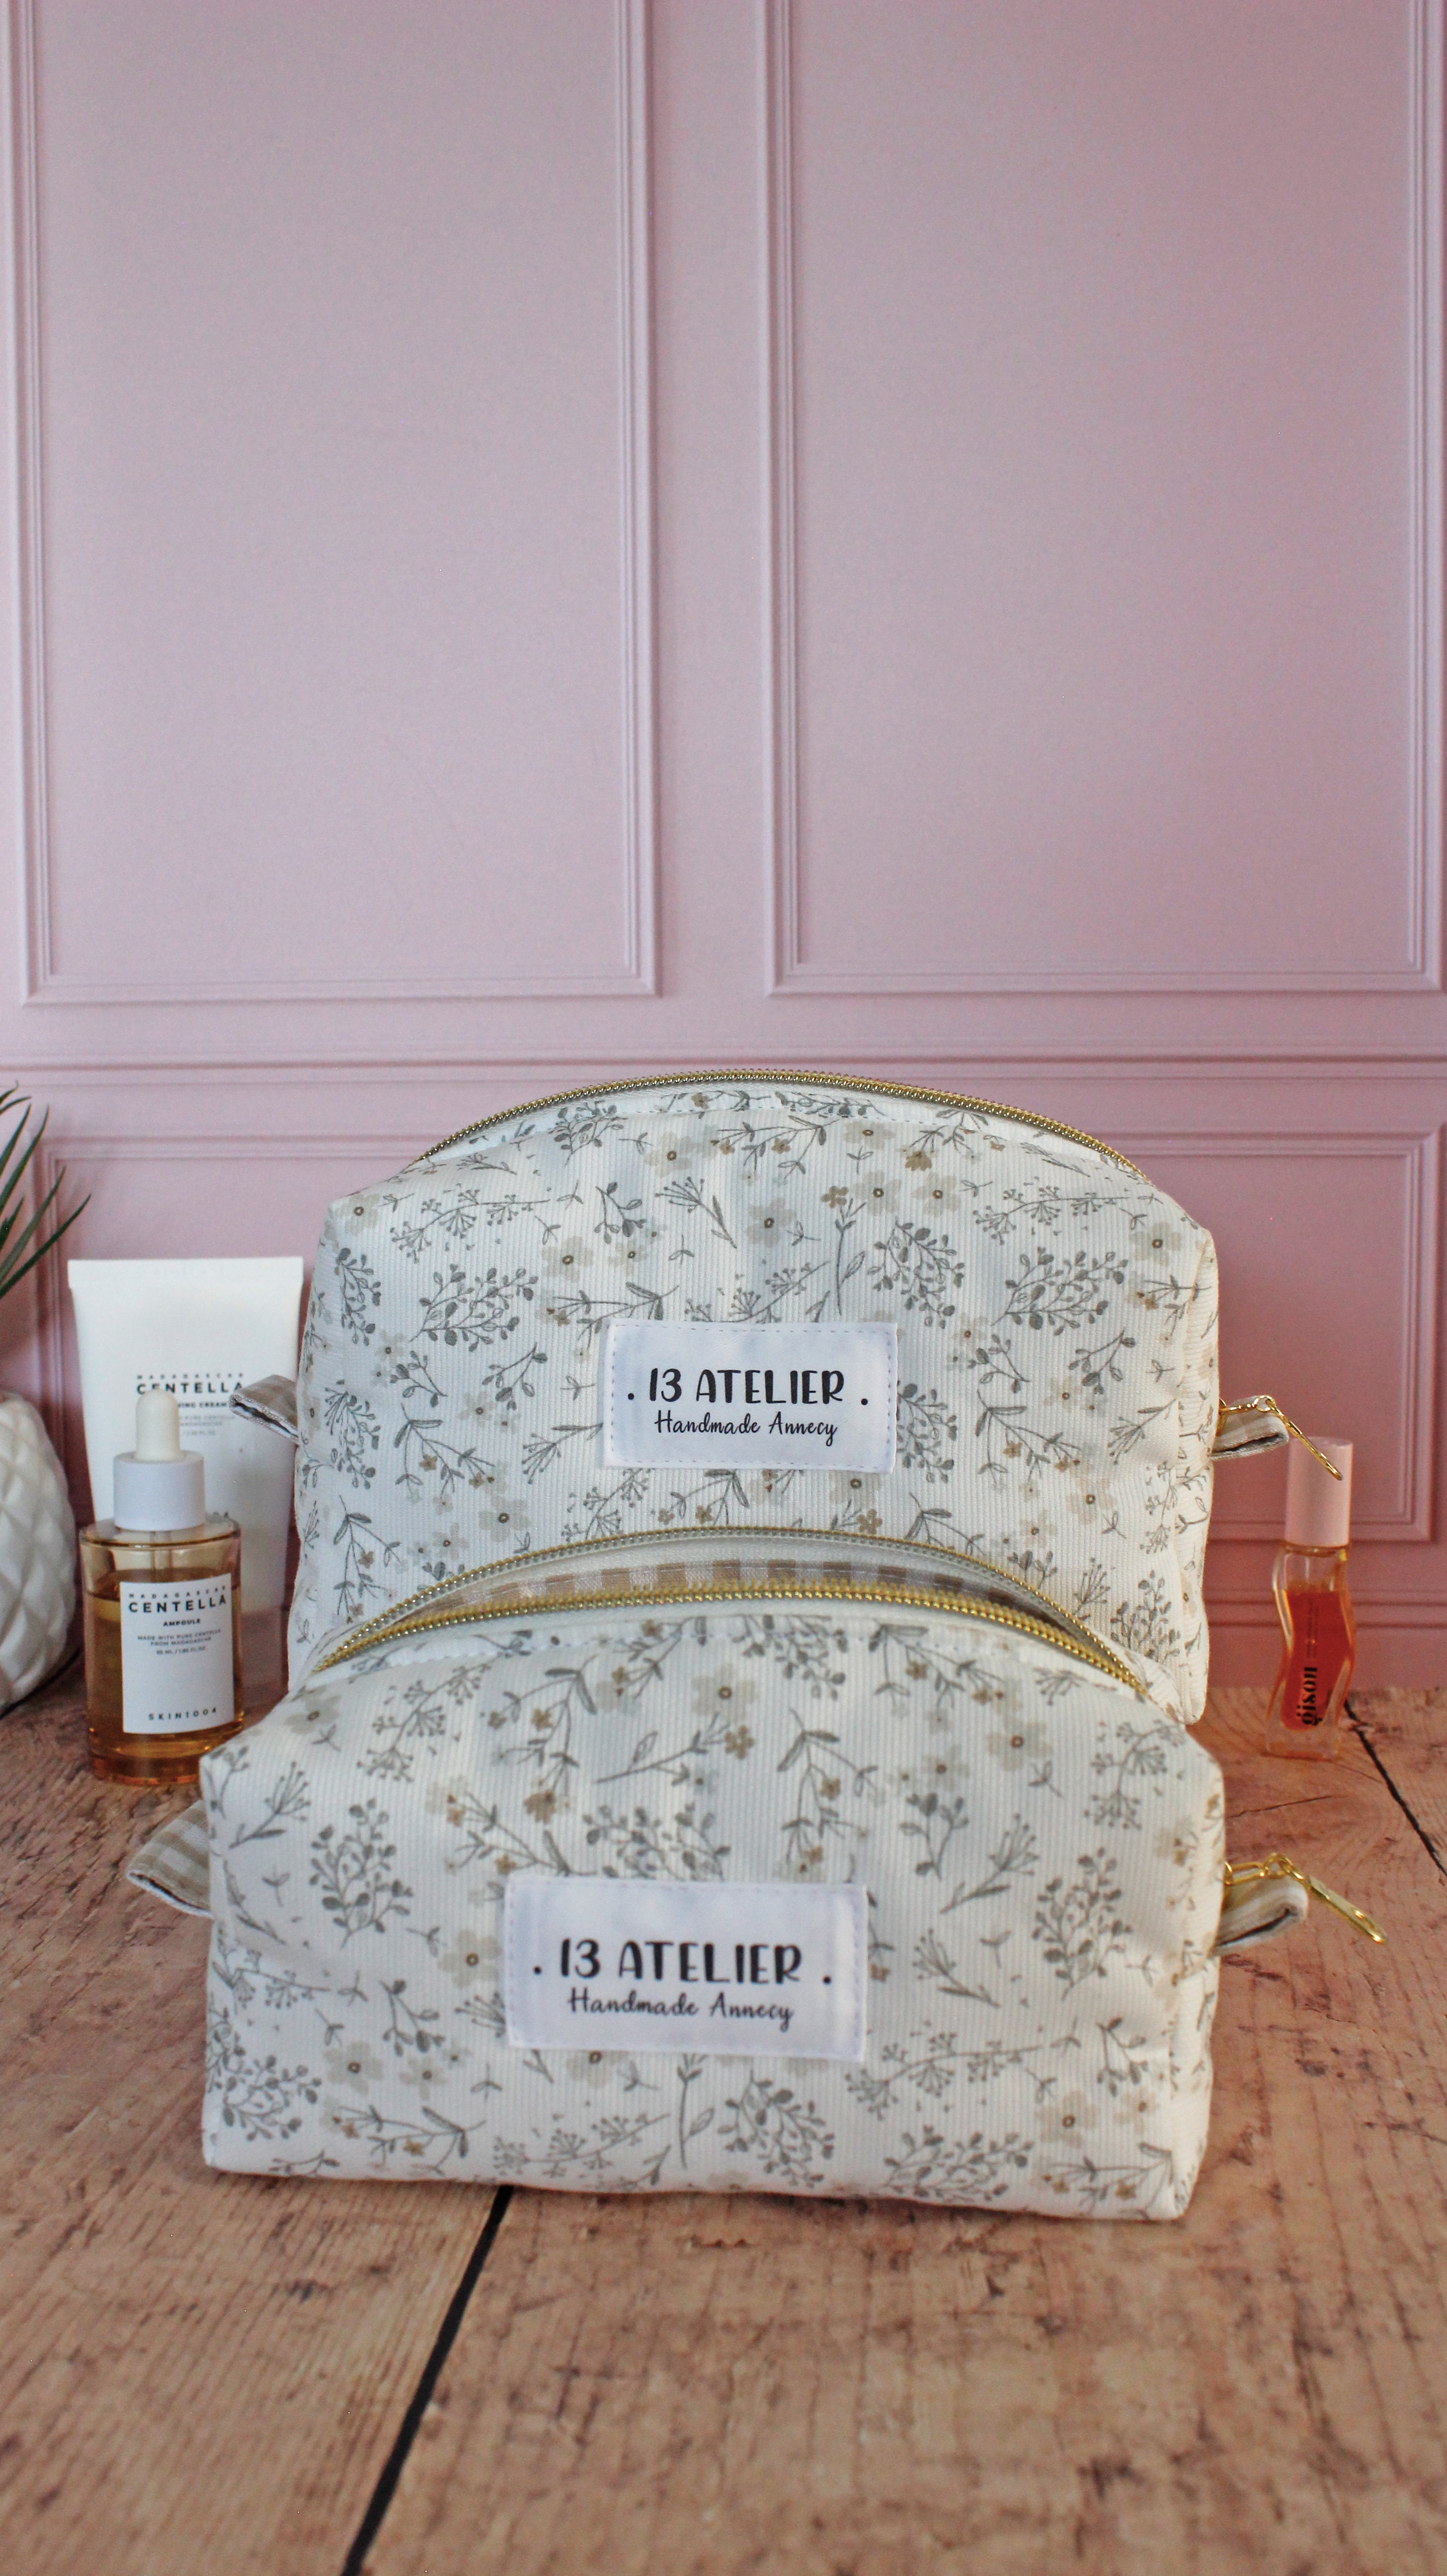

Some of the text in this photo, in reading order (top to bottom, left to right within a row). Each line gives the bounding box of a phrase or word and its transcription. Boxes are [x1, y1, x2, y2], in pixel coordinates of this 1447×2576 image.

[137, 1382, 242, 1394] CENTELLA
[649, 1368, 844, 1405] 13 ATELIER
[654, 1409, 838, 1447] Handmade Annecy
[129, 1594, 226, 1613] CENTELLA
[163, 1618, 201, 1626] AMPOULE
[149, 1706, 217, 1721] SKIN1004
[561, 1938, 802, 1984] 13 ATELIER
[568, 1987, 794, 2032] Handmade Annecy
